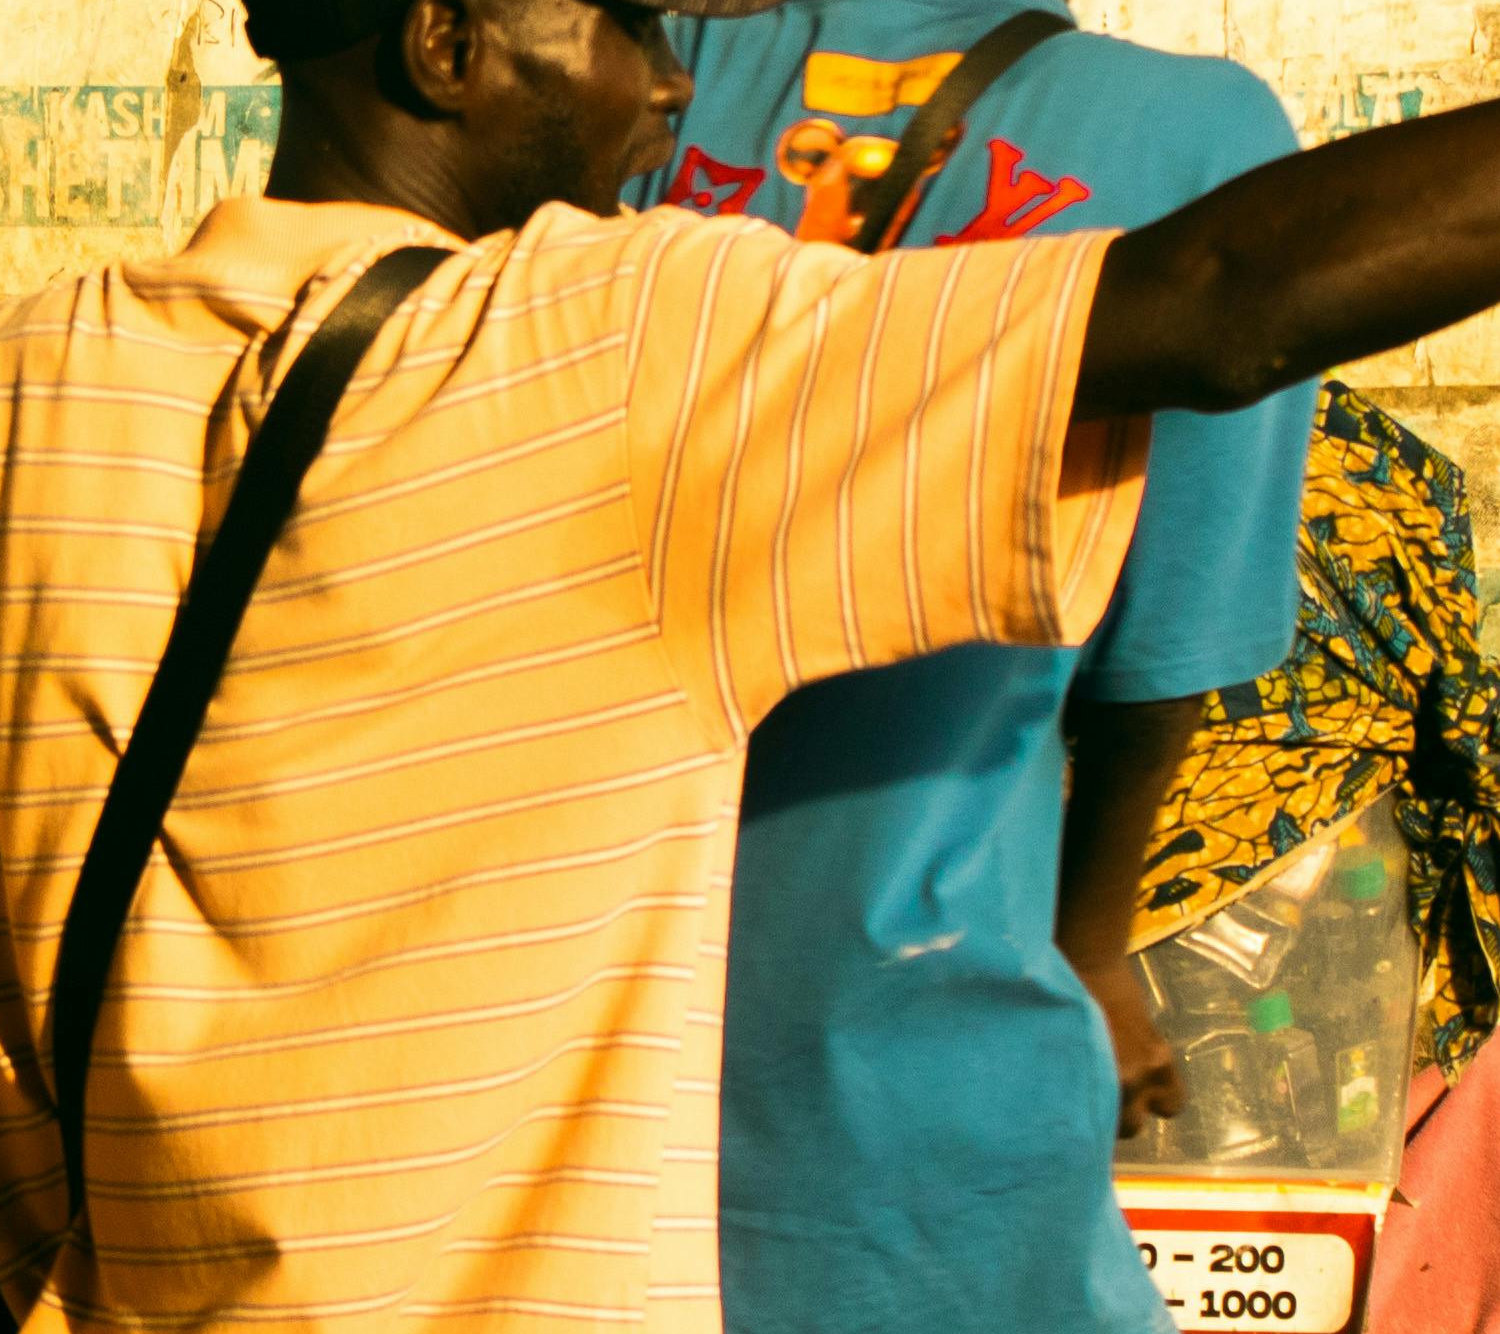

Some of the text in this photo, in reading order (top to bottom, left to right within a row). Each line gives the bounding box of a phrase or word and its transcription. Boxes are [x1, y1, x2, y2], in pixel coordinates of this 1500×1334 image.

[45, 91, 226, 138] KASHM
[1209, 1244, 1285, 1273] 200
[1199, 1289, 1297, 1320] 1000
